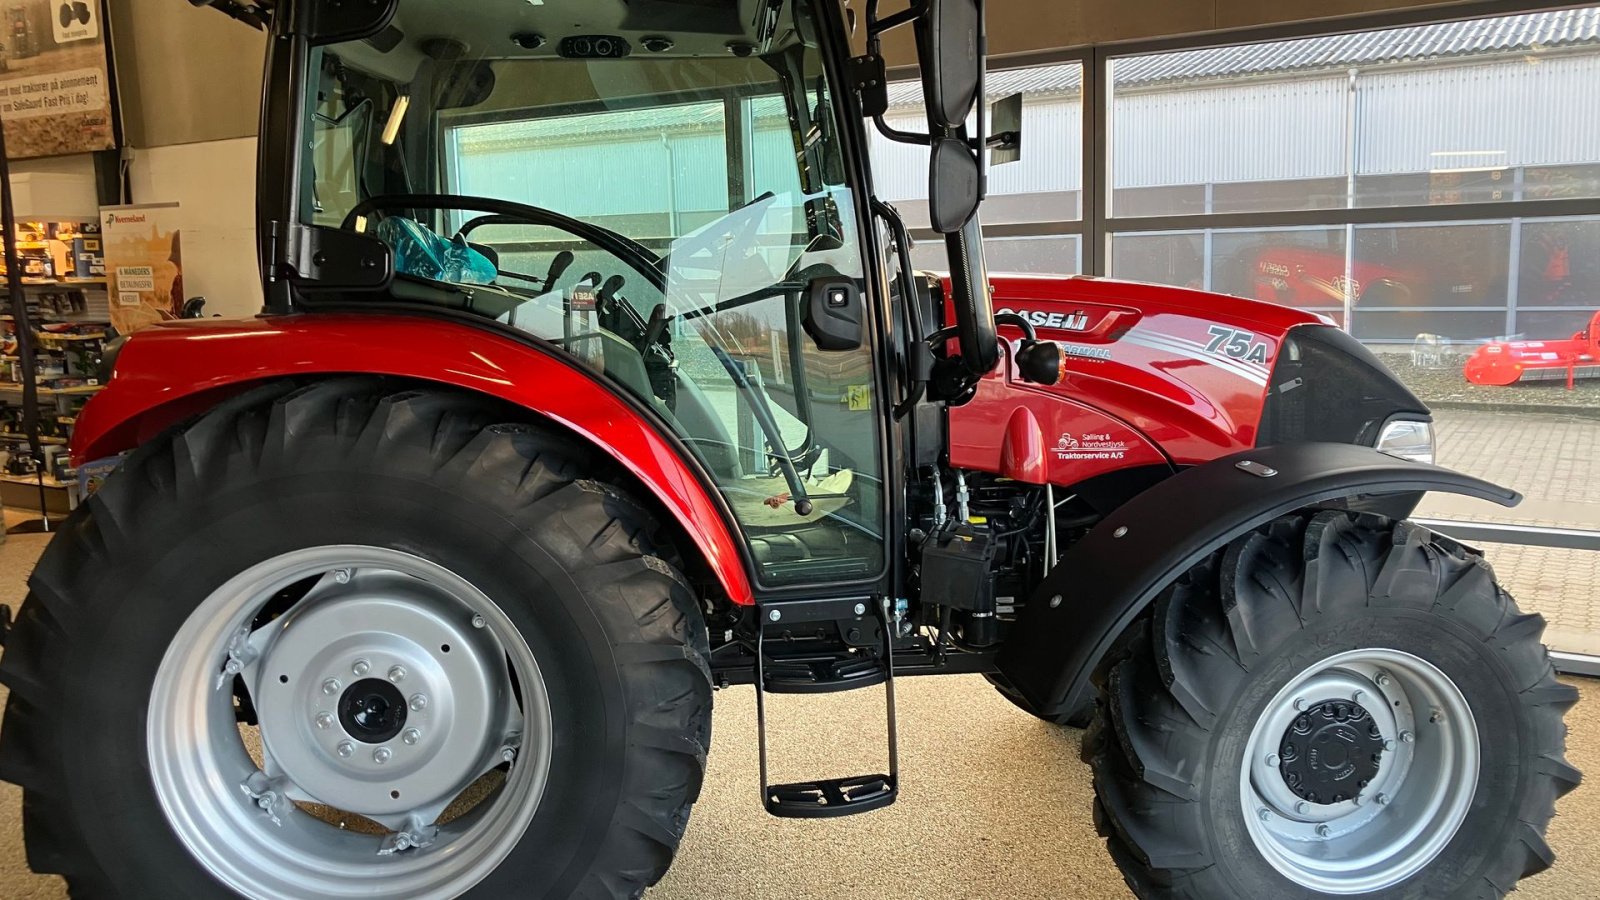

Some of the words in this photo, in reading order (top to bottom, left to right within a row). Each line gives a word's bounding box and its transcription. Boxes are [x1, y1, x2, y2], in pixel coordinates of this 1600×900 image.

[50, 78, 59, 92] på
[60, 74, 98, 90] abonnement
[44, 96, 58, 108] Fast
[59, 94, 71, 106] Pris
[76, 91, 89, 106] dag!
[114, 213, 146, 224] Kverneland
[1061, 343, 1112, 359] ARMALL
[1203, 324, 1267, 365] 75A
[1082, 433, 1104, 441] Salling
[1082, 441, 1125, 449] Nordvestjysk
